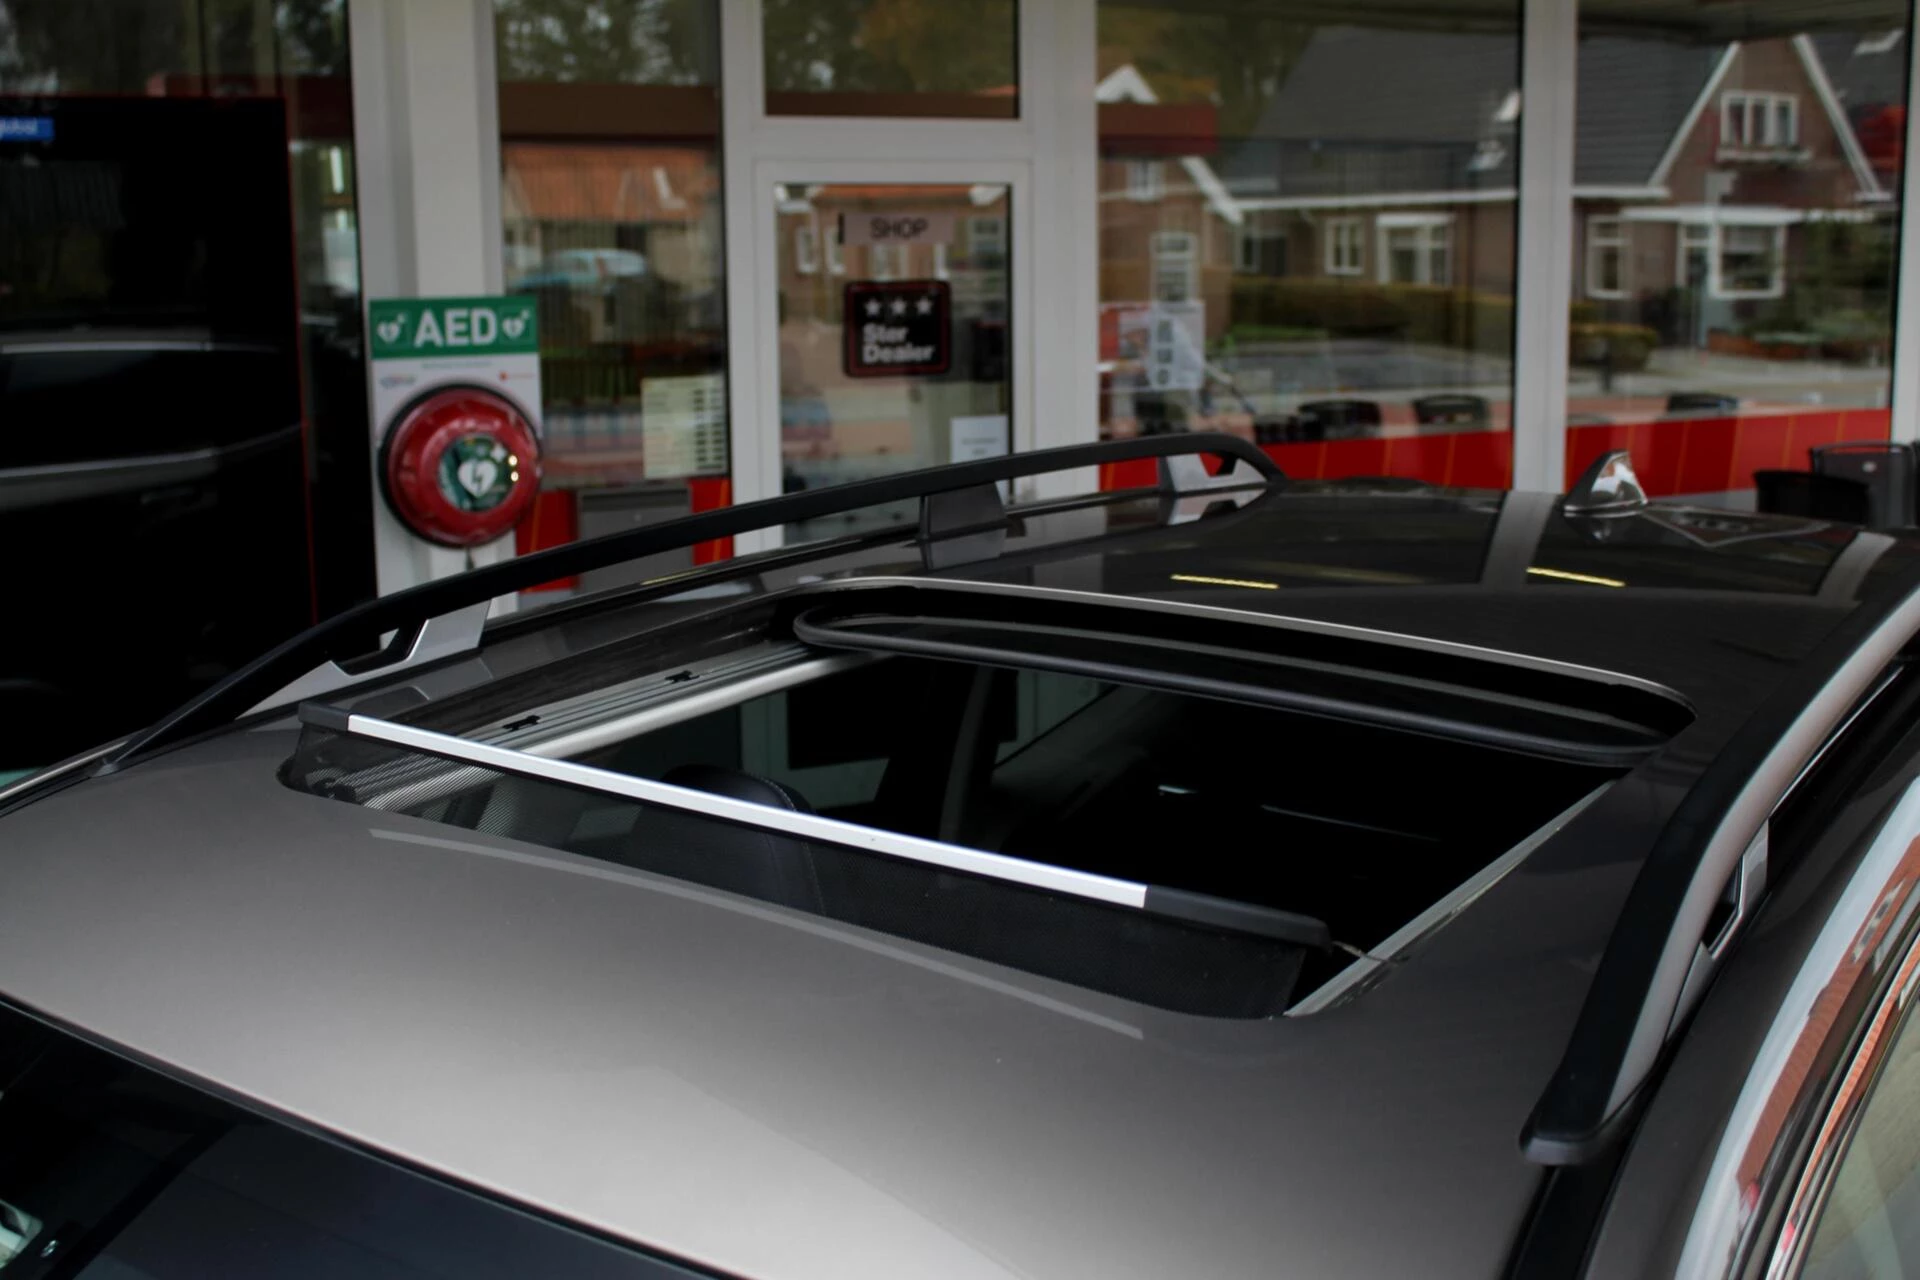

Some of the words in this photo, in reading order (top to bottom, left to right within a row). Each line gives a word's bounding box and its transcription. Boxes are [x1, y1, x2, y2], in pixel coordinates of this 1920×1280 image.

[871, 218, 928, 238] SHOP
[414, 308, 497, 348] AED
[863, 323, 909, 342] Ster
[863, 343, 935, 363] Dealer
